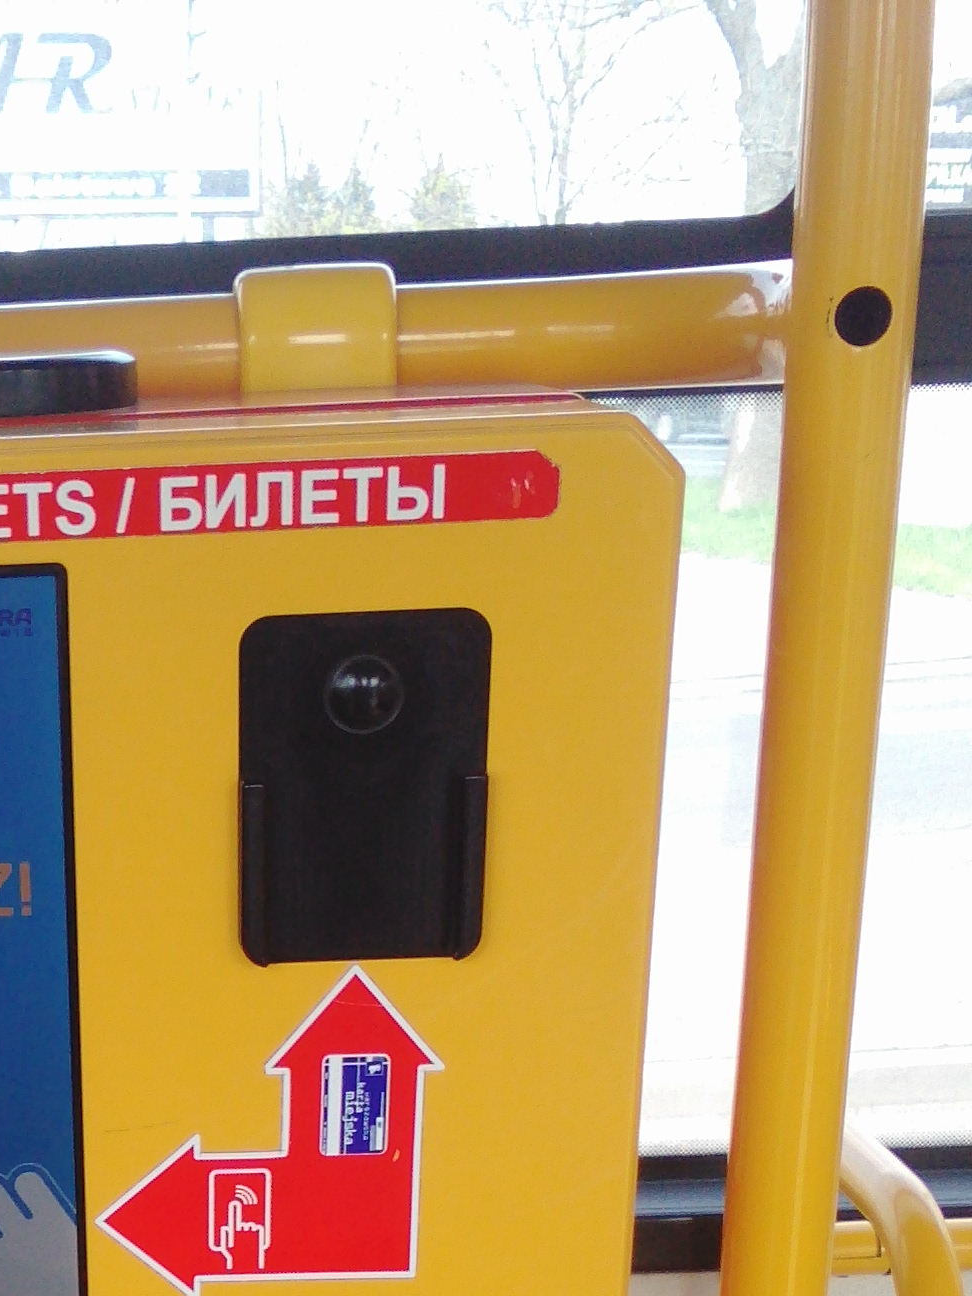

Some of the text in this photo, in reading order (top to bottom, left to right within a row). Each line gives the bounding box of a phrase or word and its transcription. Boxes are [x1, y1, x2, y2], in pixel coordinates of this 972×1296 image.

[116, 477, 134, 534] /
[160, 464, 447, 532] БИЛЕТЫ
[342, 1091, 358, 1145] miejska
